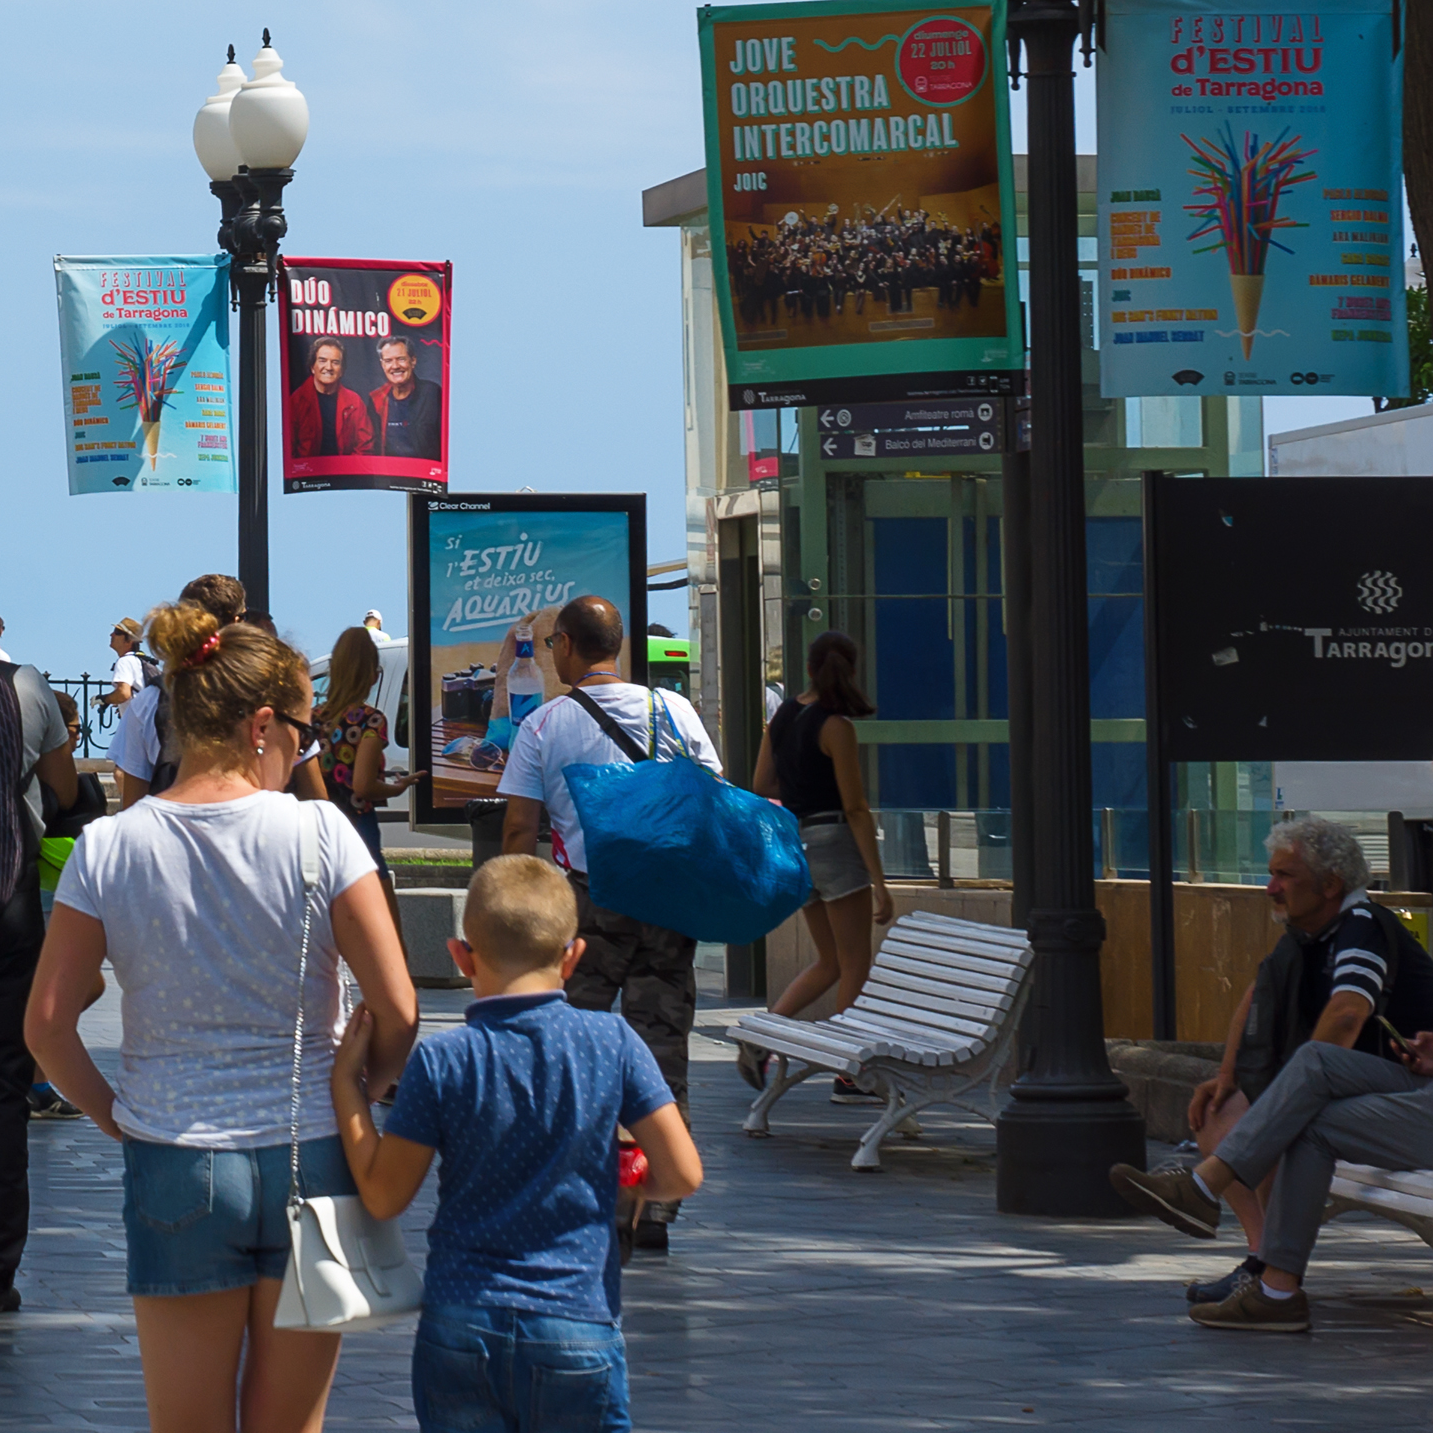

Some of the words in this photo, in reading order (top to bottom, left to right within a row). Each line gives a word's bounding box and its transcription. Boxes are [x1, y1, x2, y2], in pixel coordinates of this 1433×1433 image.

[914, 29, 969, 41] diumenge
[1170, 14, 1325, 44] FESTIVAL
[730, 36, 797, 75] JOVE
[911, 43, 927, 58] 22
[930, 40, 972, 57] JULIOL
[930, 61, 947, 70] 20
[947, 60, 955, 69] h
[1170, 45, 1323, 75] d'ESTIU
[731, 74, 891, 118] ORQUESTRA
[1171, 83, 1192, 97] de
[1195, 77, 1323, 101] Tarragona
[1170, 106, 1214, 115] JULIOL
[1227, 105, 1295, 115] SETEMBRE
[733, 113, 959, 161] INTERCOMARCAL
[734, 172, 768, 192] JOIC
[100, 270, 187, 288] FESTIVAL
[101, 288, 186, 306] d'ESTIU
[290, 276, 332, 306] DÚO
[396, 288, 405, 297] 21
[103, 311, 115, 319] de
[116, 308, 188, 321] Tarragona
[291, 306, 392, 338] DINÁMICO
[904, 410, 948, 421] Amfiteatre
[951, 407, 974, 419] romà
[885, 438, 909, 449] Balcó
[911, 437, 926, 449] del
[927, 435, 976, 448] Mediterrani
[439, 502, 459, 510] Clear
[460, 502, 491, 510] Channel
[464, 576, 482, 591] et
[483, 571, 526, 589] deixa
[529, 569, 555, 583] sec,
[1338, 627, 1418, 636] AJUNTAMENT
